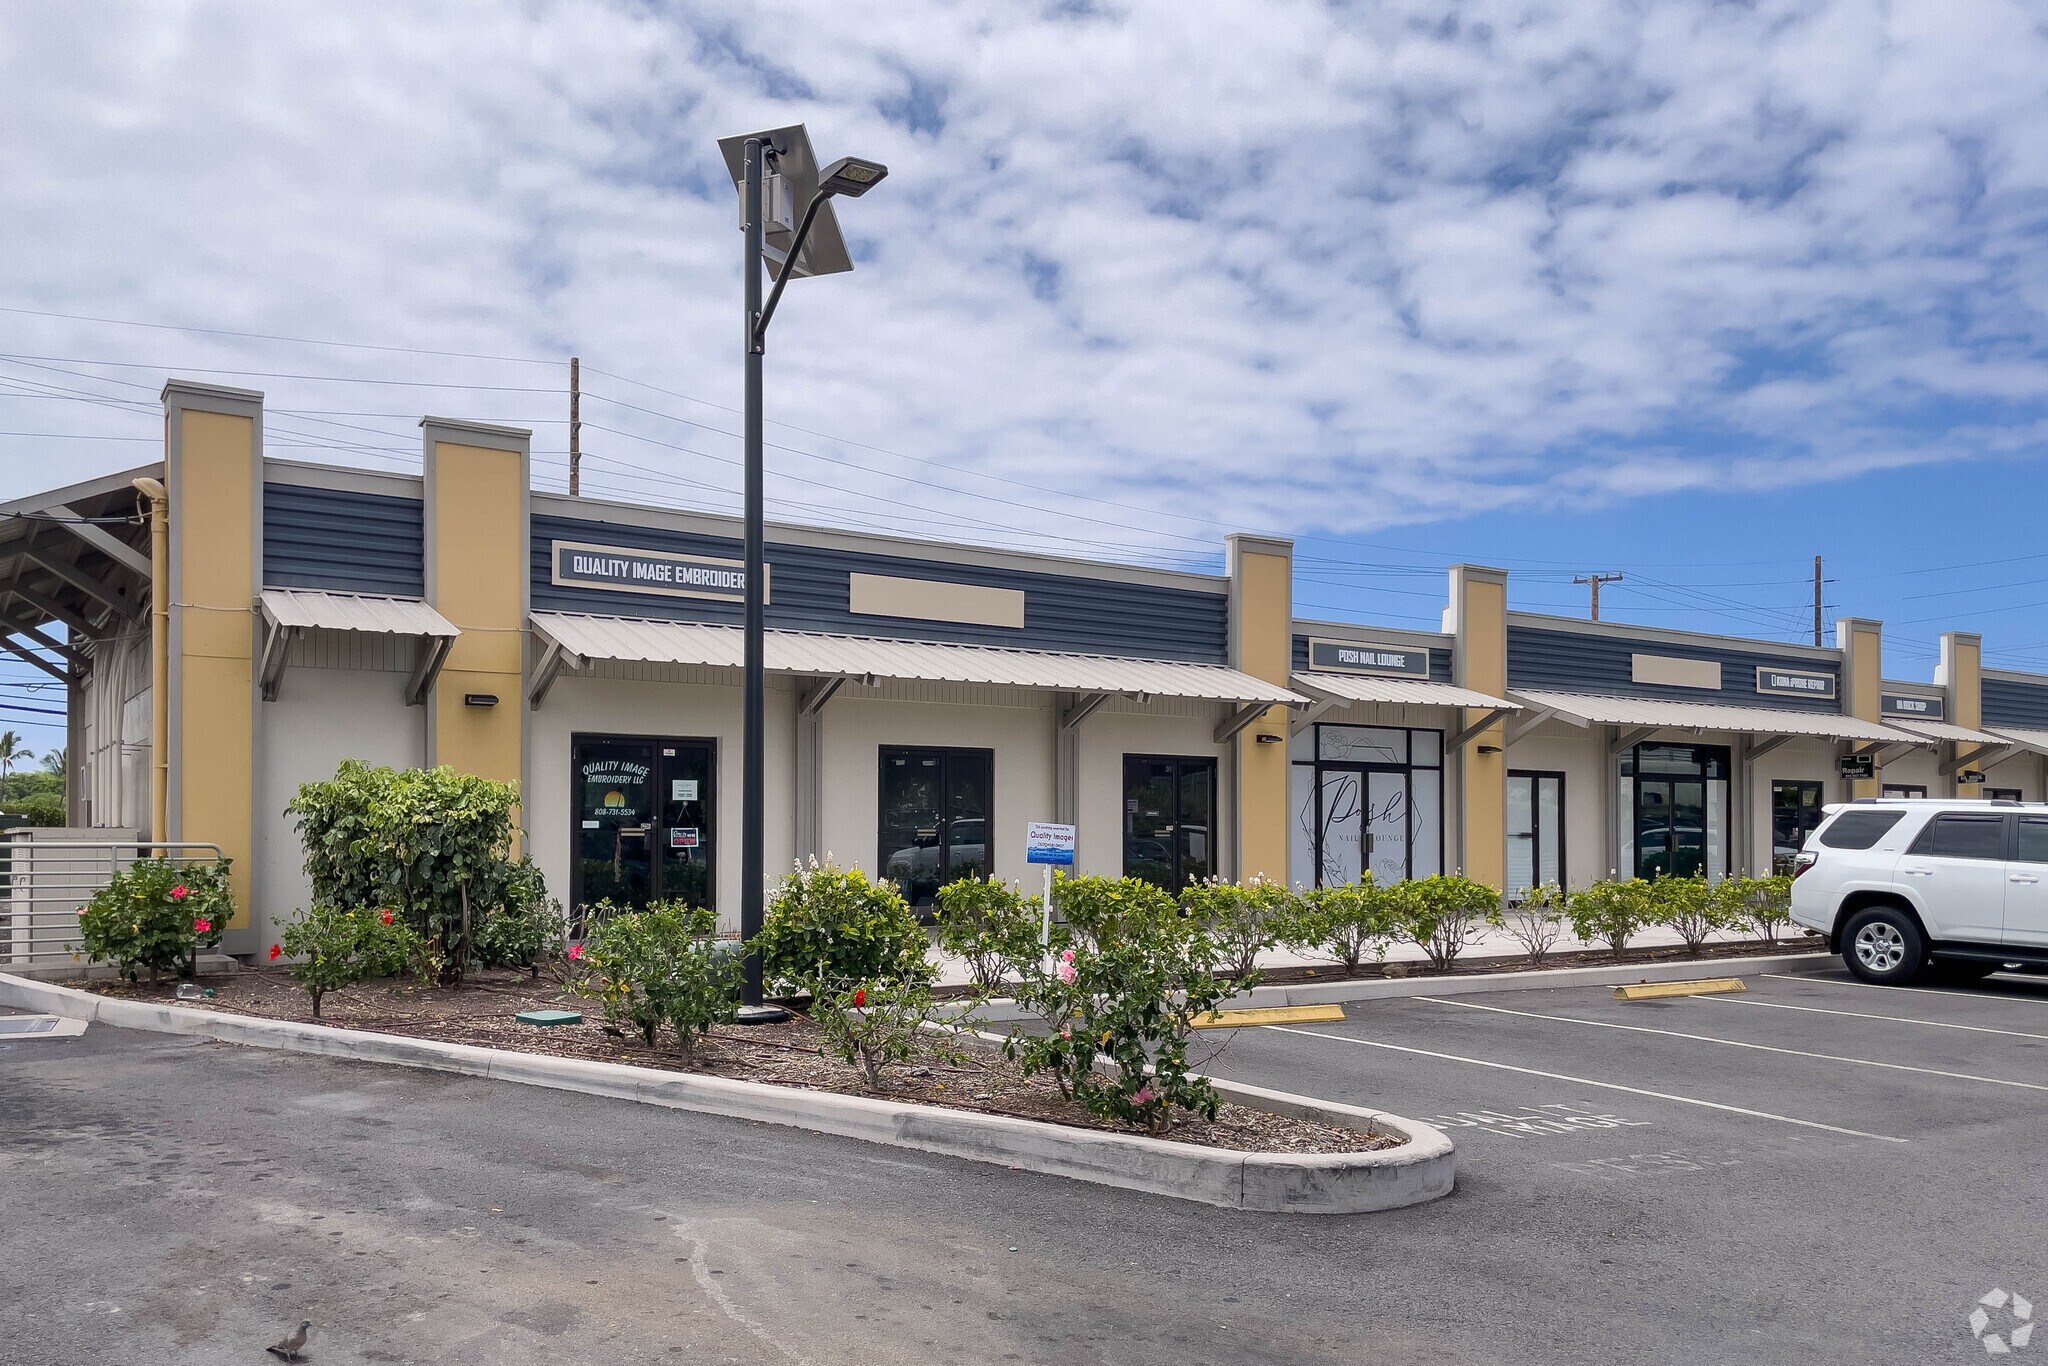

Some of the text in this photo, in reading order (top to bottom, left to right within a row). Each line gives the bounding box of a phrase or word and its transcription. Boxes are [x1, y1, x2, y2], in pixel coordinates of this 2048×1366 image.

[573, 556, 745, 589] QUALITY IMAGE EMBROIDER
[1338, 649, 1405, 668] POSH NAIL LOUNGE
[582, 761, 650, 777] QUALITY IMAGE
[587, 774, 644, 784] EMBROIDERY LLC
[594, 808, 636, 816] 808-731-5534
[1322, 775, 1406, 844] Posh
[1030, 830, 1073, 842] Quality Images
[1338, 834, 1404, 842] NAIL OUNGE
[1478, 1114, 1653, 1138] IMAGE
